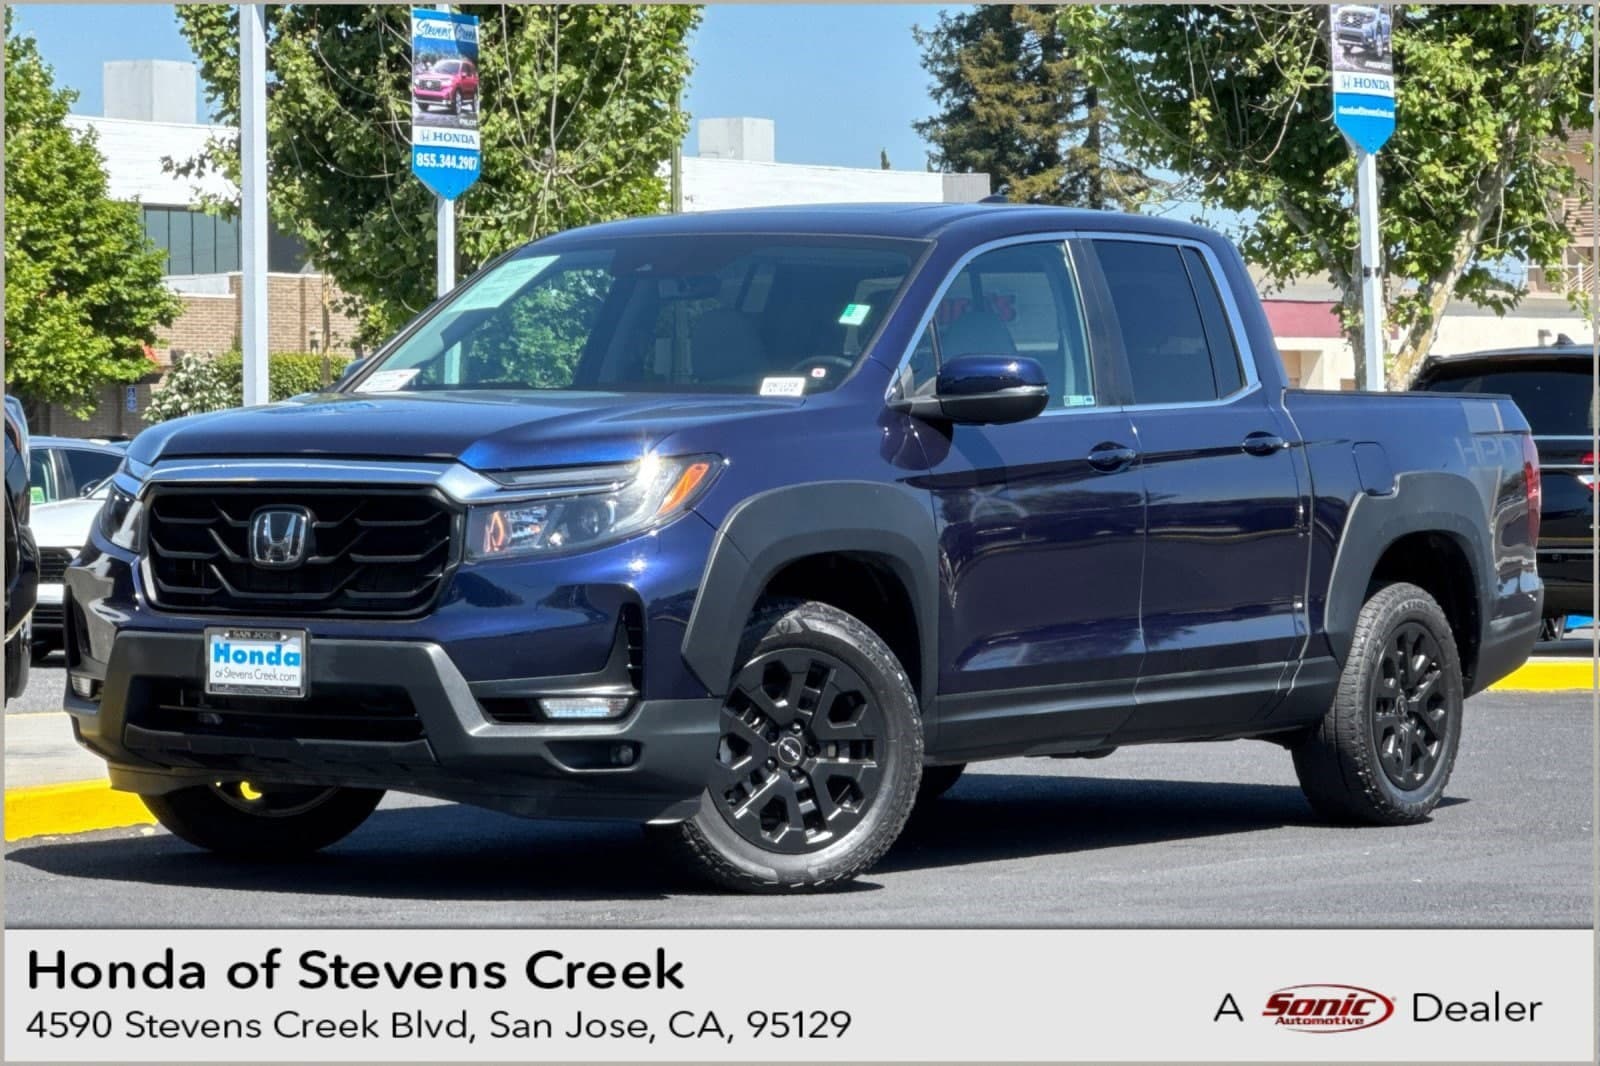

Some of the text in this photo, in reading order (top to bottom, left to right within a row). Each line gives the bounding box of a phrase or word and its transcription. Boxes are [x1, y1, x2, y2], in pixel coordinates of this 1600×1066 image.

[1353, 77, 1391, 91] HONDA
[433, 132, 475, 144] HONDA
[1455, 437, 1519, 466] HPD
[214, 643, 301, 667] Honda
[224, 667, 253, 680] Stevens
